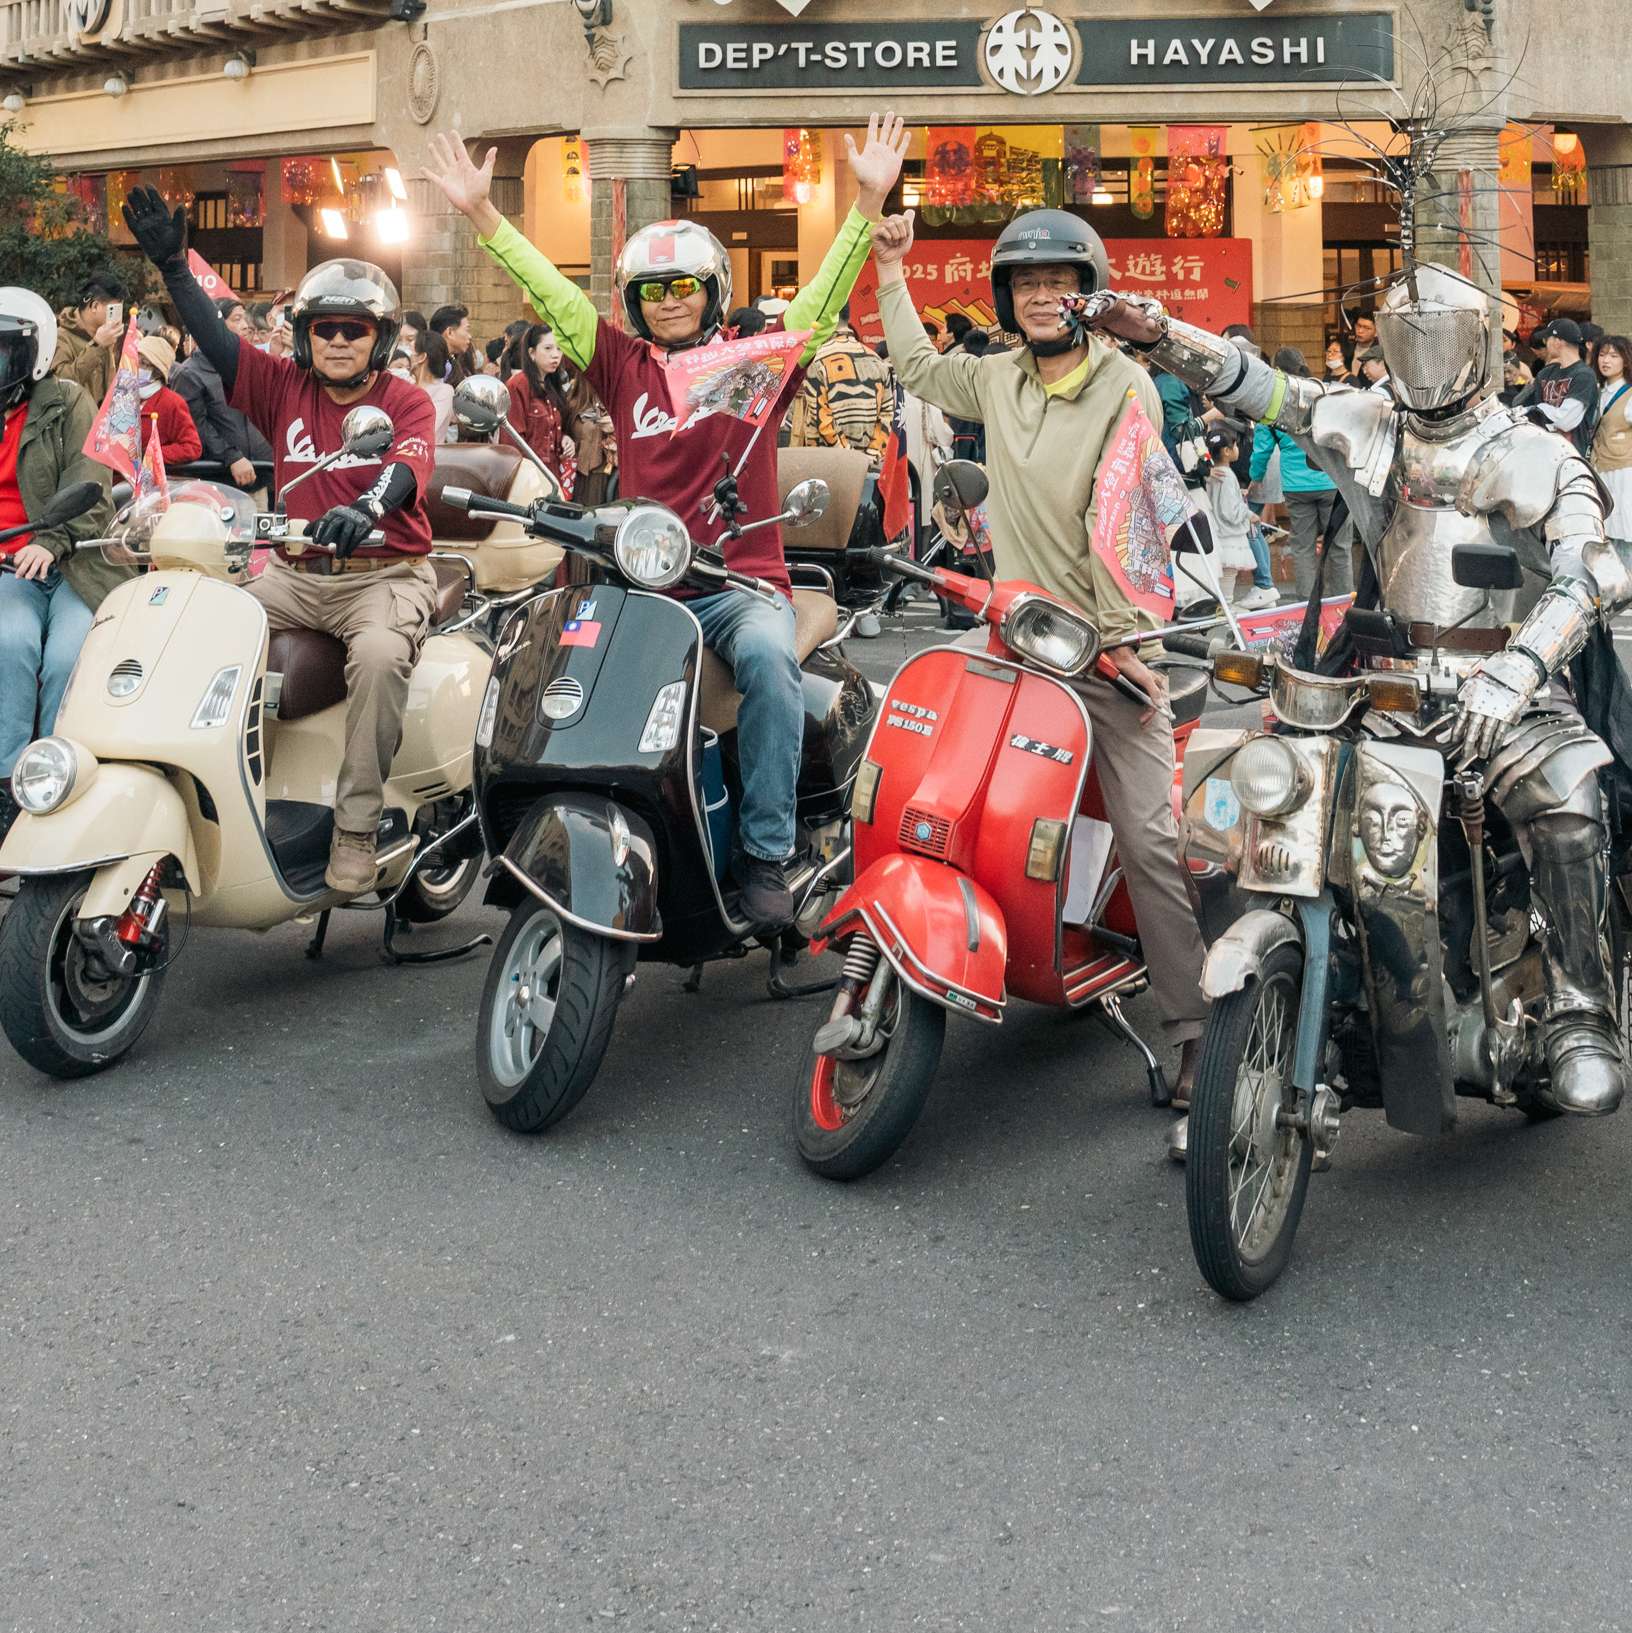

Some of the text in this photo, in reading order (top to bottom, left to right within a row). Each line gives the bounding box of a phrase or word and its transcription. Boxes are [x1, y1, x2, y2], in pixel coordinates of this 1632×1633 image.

[1130, 36, 1327, 66] HAYASHI
[902, 263, 938, 281] 025
[891, 699, 939, 721] vespa
